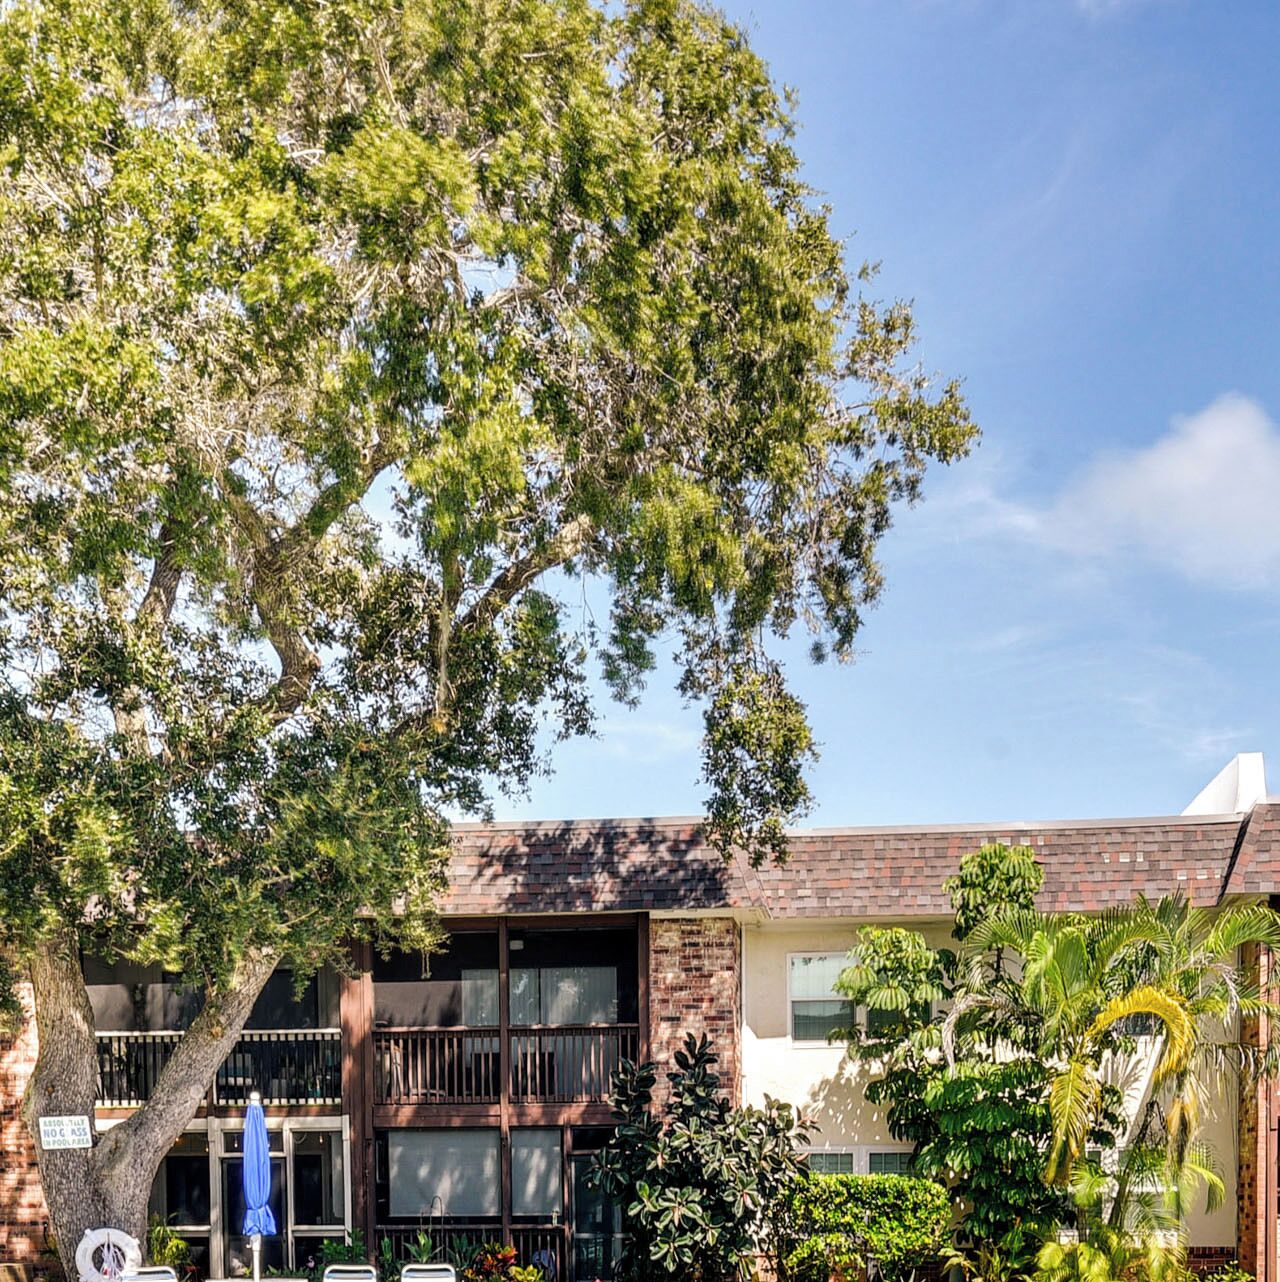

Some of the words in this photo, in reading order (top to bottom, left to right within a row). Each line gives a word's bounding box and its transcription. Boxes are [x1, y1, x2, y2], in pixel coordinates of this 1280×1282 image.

[43, 1128, 57, 1138] NO
[59, 1127, 87, 1137] GASS
[52, 1138, 71, 1146] POOL
[72, 1137, 90, 1146] AREA
